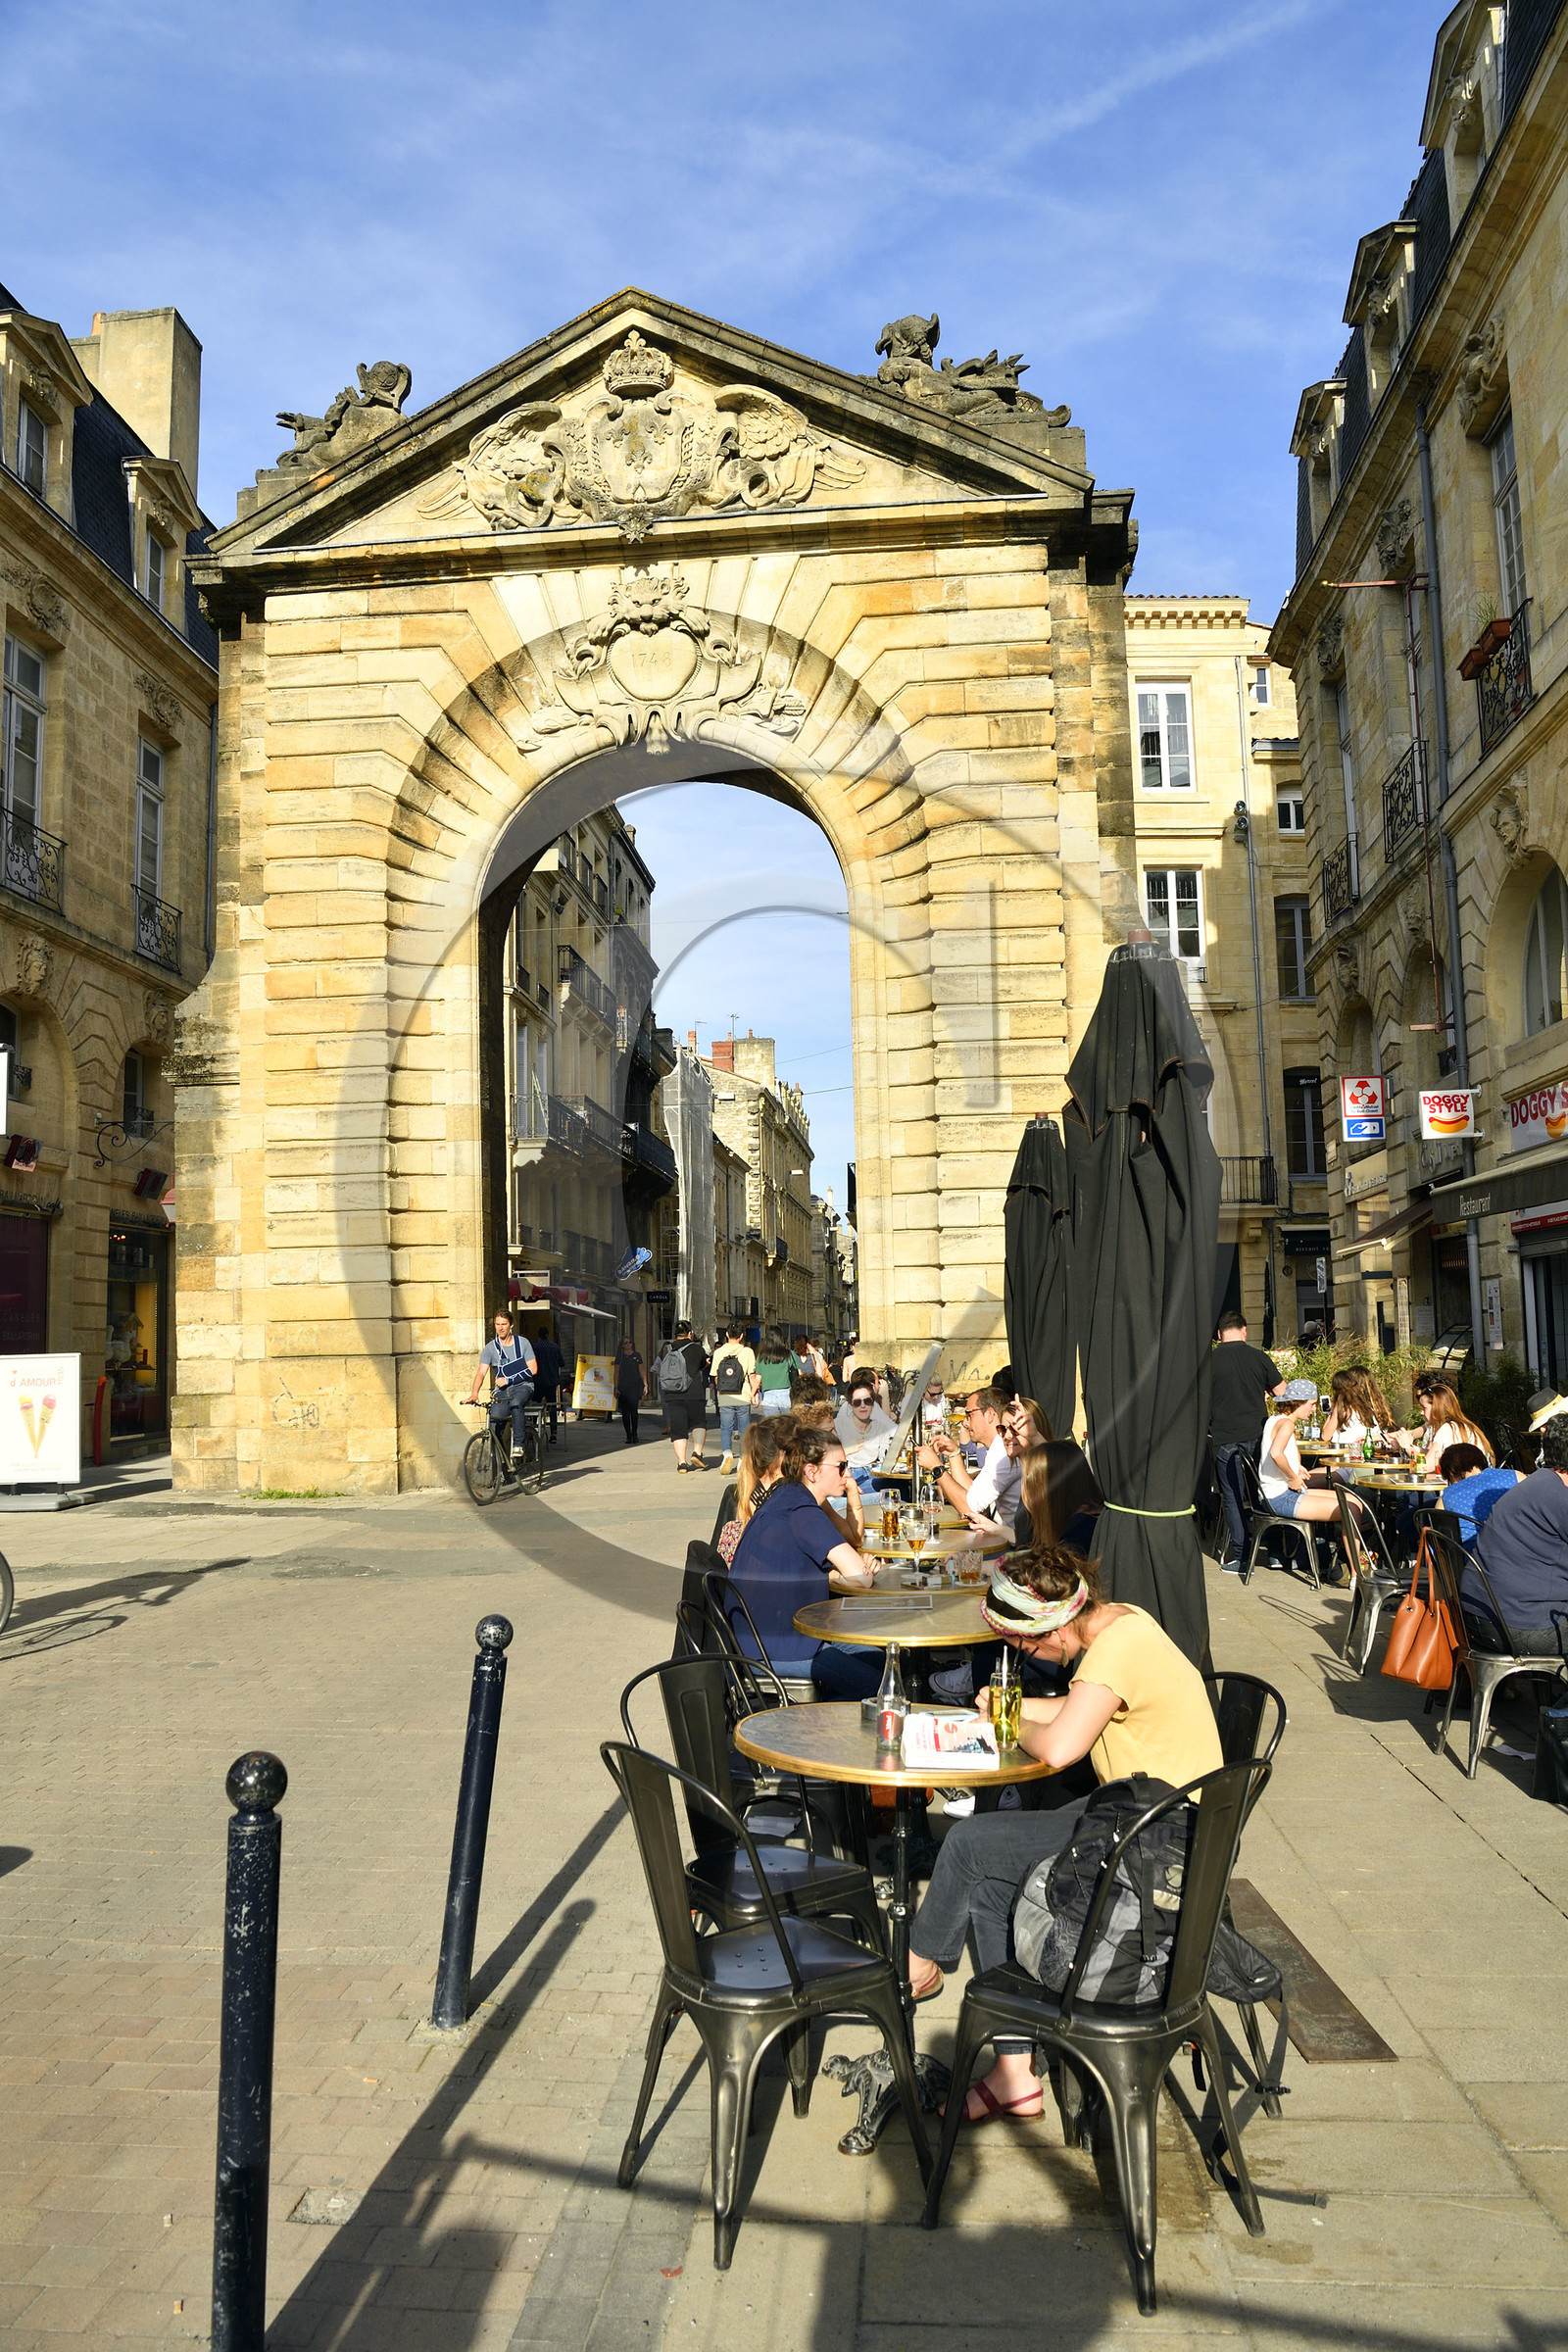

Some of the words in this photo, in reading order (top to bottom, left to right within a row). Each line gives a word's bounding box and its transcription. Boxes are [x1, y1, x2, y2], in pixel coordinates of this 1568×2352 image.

[632, 651, 673, 668] 1748
[1422, 1094, 1470, 1105] DOGGY
[1429, 1102, 1468, 1113] STYLE
[1510, 1086, 1557, 1128] DOGGY
[1459, 1193, 1492, 1217] Restaurant
[20, 1378, 56, 1388] AMOUR
